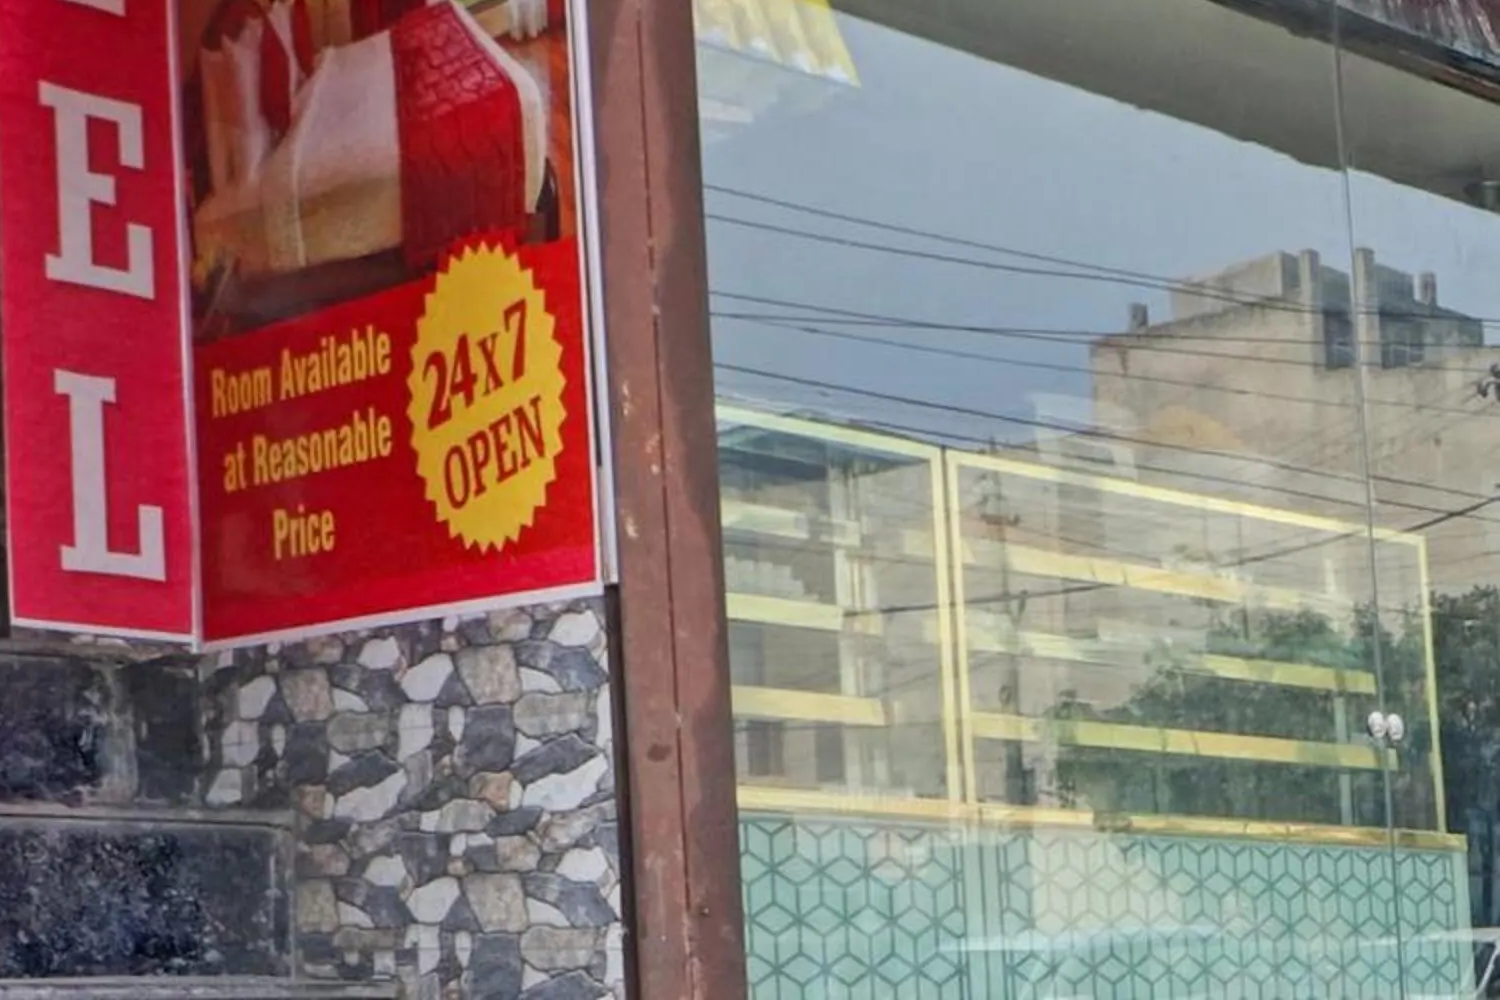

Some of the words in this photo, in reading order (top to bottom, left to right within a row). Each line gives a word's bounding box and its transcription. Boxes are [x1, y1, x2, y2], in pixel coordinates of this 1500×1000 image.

[211, 367, 273, 419] Room
[280, 324, 392, 401] Available
[223, 441, 247, 493] at
[253, 406, 393, 486] Reasonable
[443, 394, 546, 510] OPEN
[273, 503, 336, 560] Price
